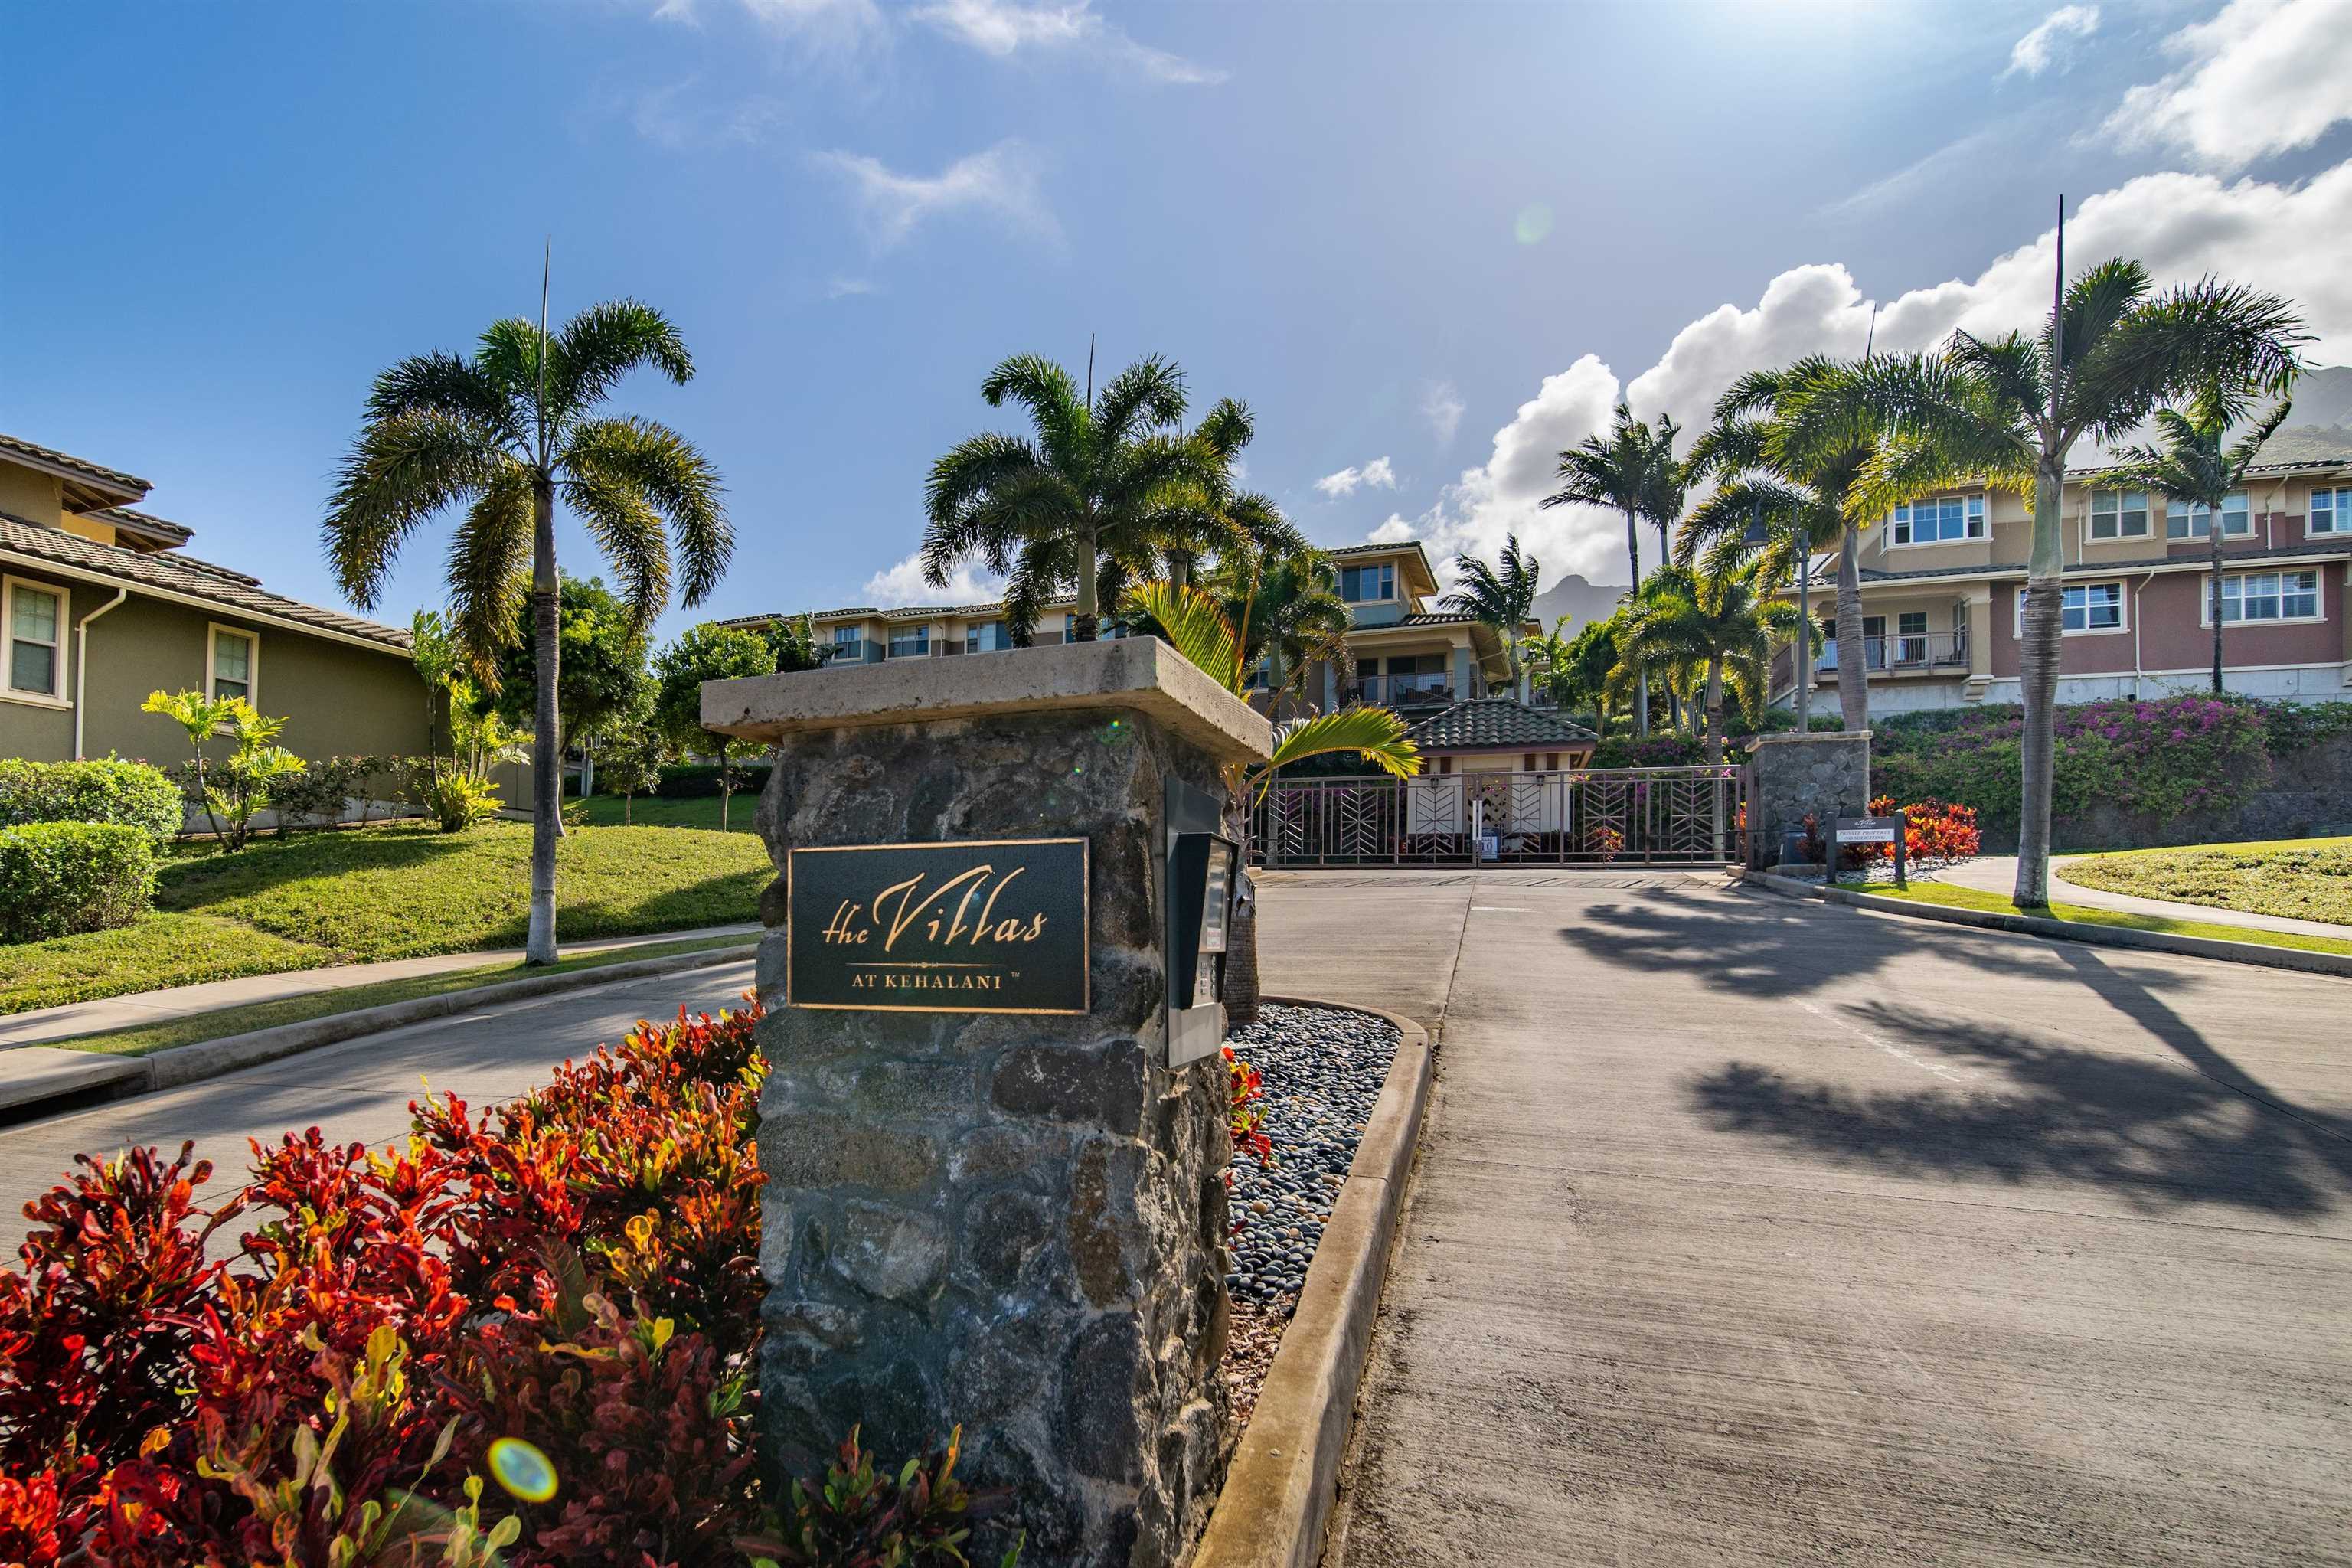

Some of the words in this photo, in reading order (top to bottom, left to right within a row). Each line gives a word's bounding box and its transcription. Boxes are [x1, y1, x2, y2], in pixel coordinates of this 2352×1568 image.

[822, 899, 869, 944] the
[873, 864, 1048, 952] Villas
[851, 974, 877, 988] AT
[884, 975, 1002, 989] KEHALANI
